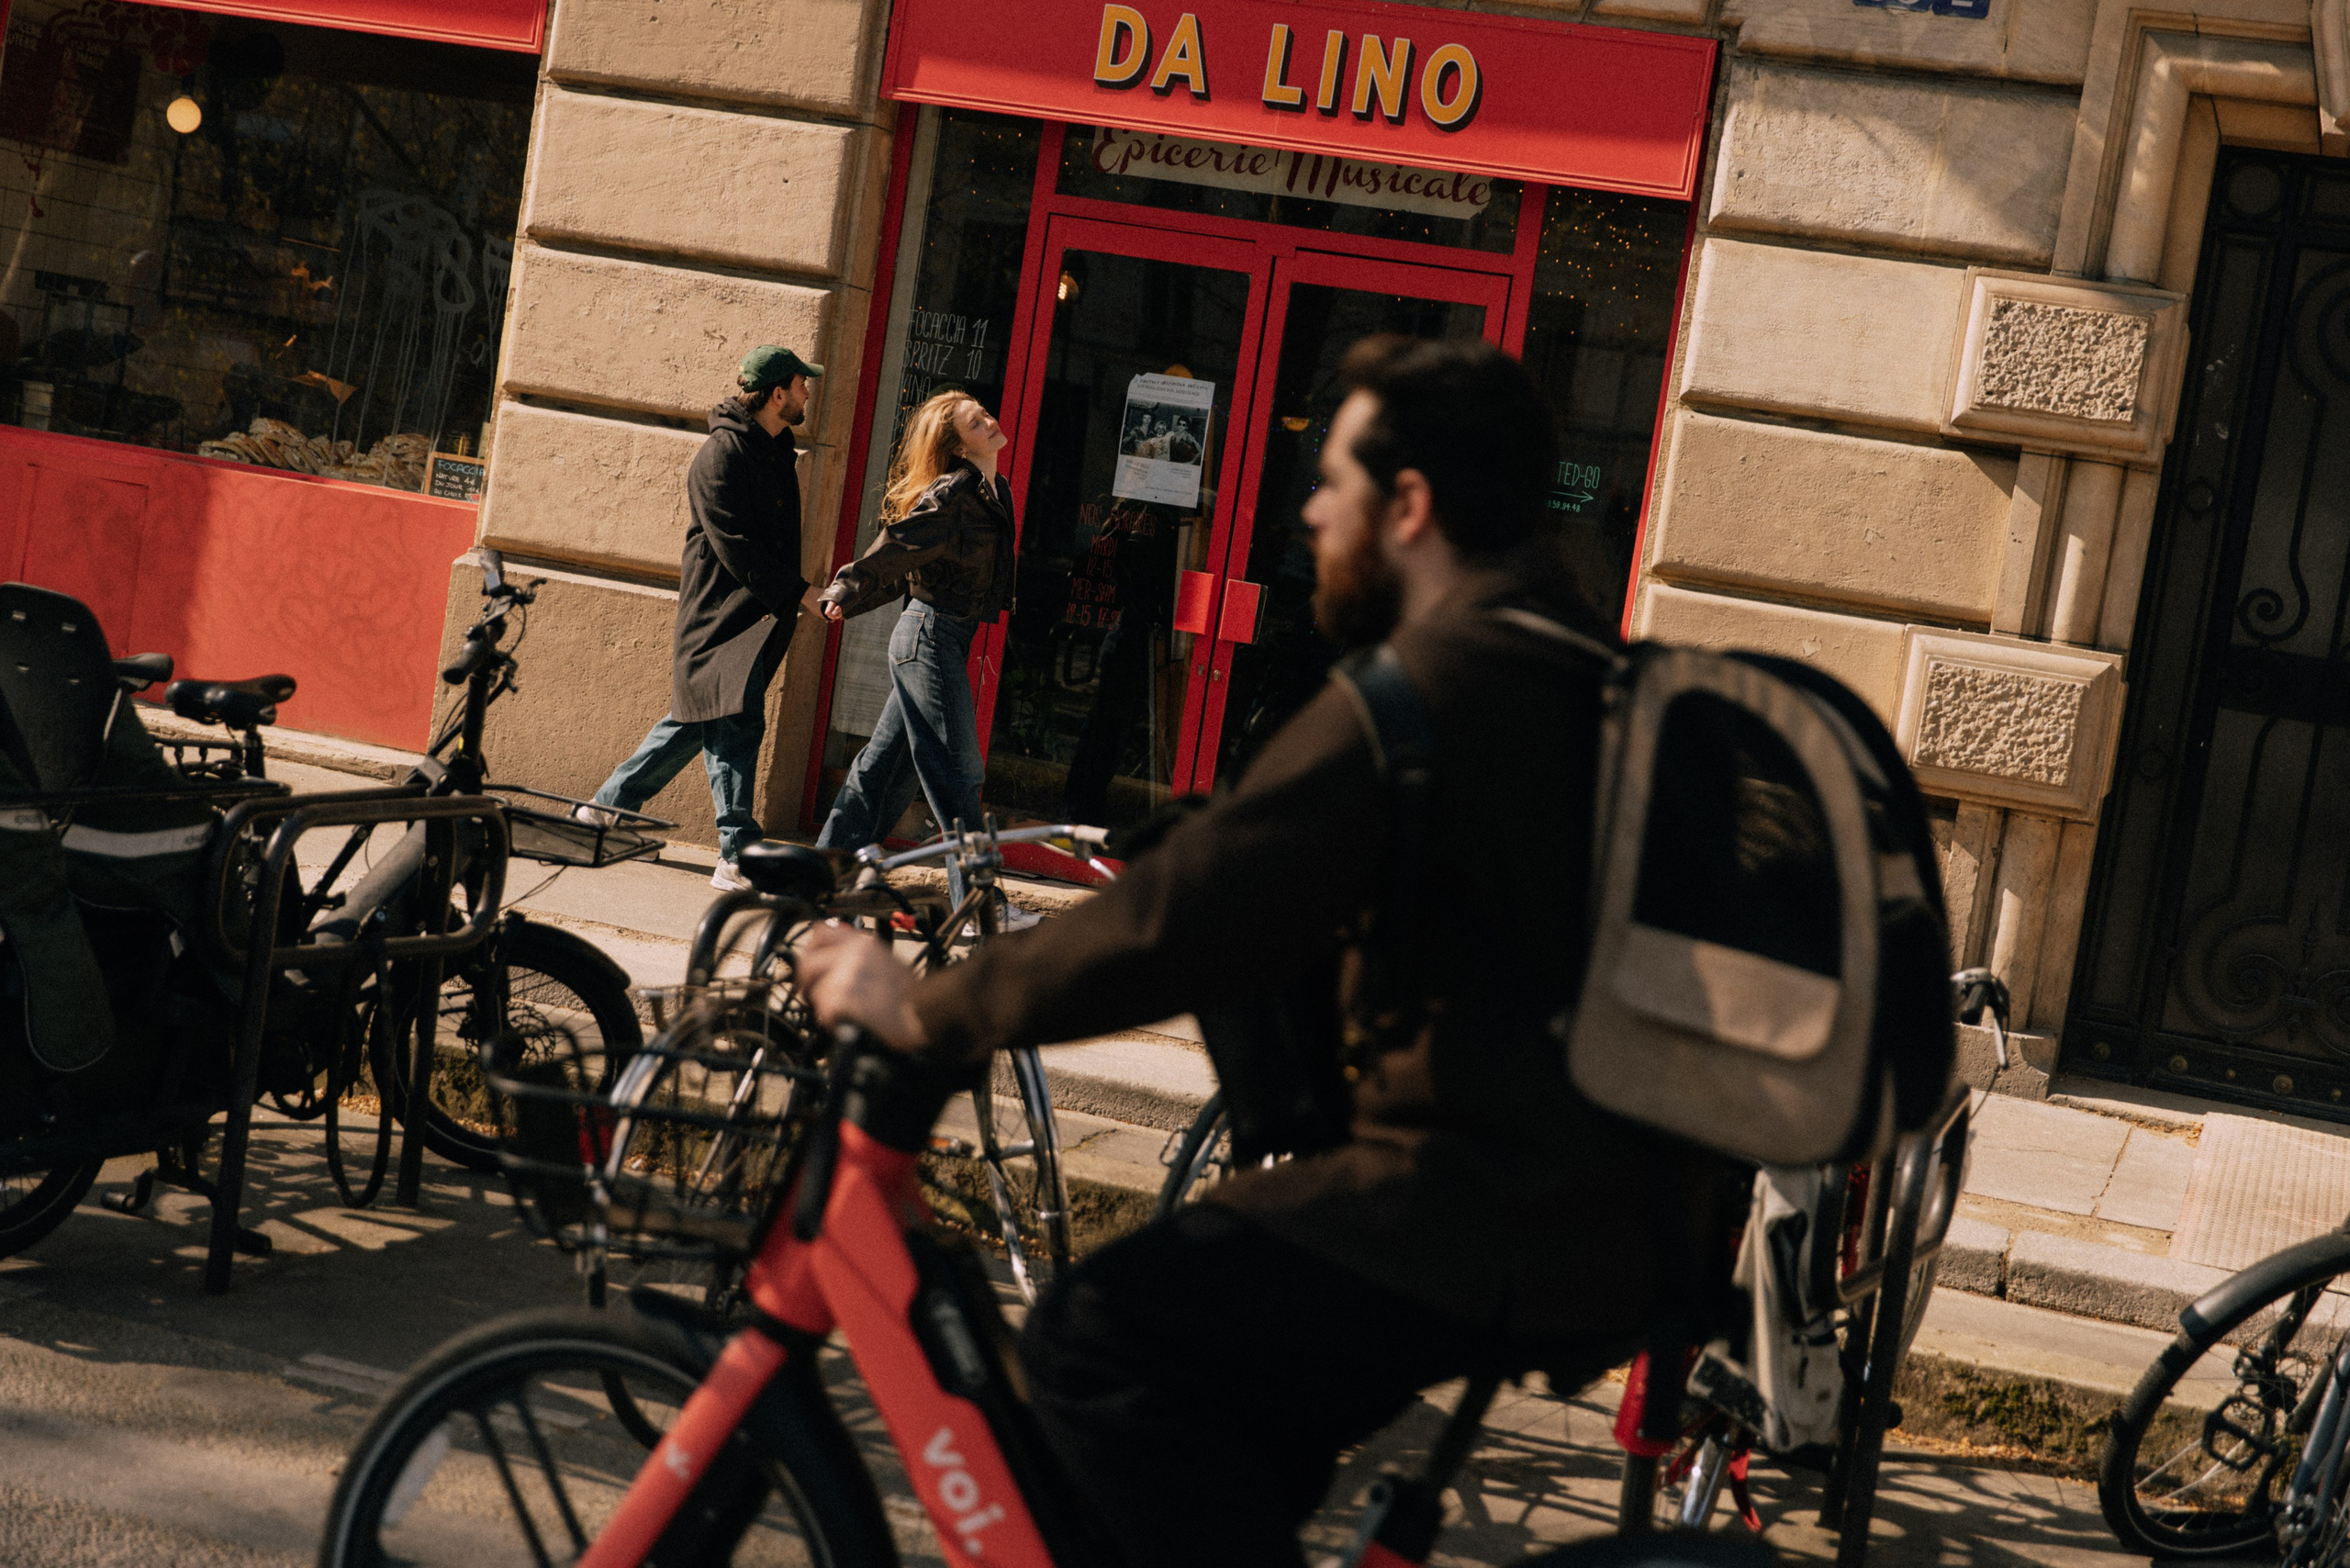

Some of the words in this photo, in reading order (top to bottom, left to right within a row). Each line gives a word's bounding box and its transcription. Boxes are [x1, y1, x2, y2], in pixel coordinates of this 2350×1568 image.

[1094, 4, 1210, 101] DA
[1262, 23, 1483, 132] LINO
[1276, 149, 1492, 207] Musicale
[906, 308, 967, 344] FOCACCIA
[971, 318, 990, 348] 11
[902, 339, 955, 375] SPRITZ
[964, 349, 982, 380] 10
[438, 460, 486, 476] FOCACCIA
[1079, 503, 1103, 528] NOS
[1090, 534, 1118, 558] MARDI
